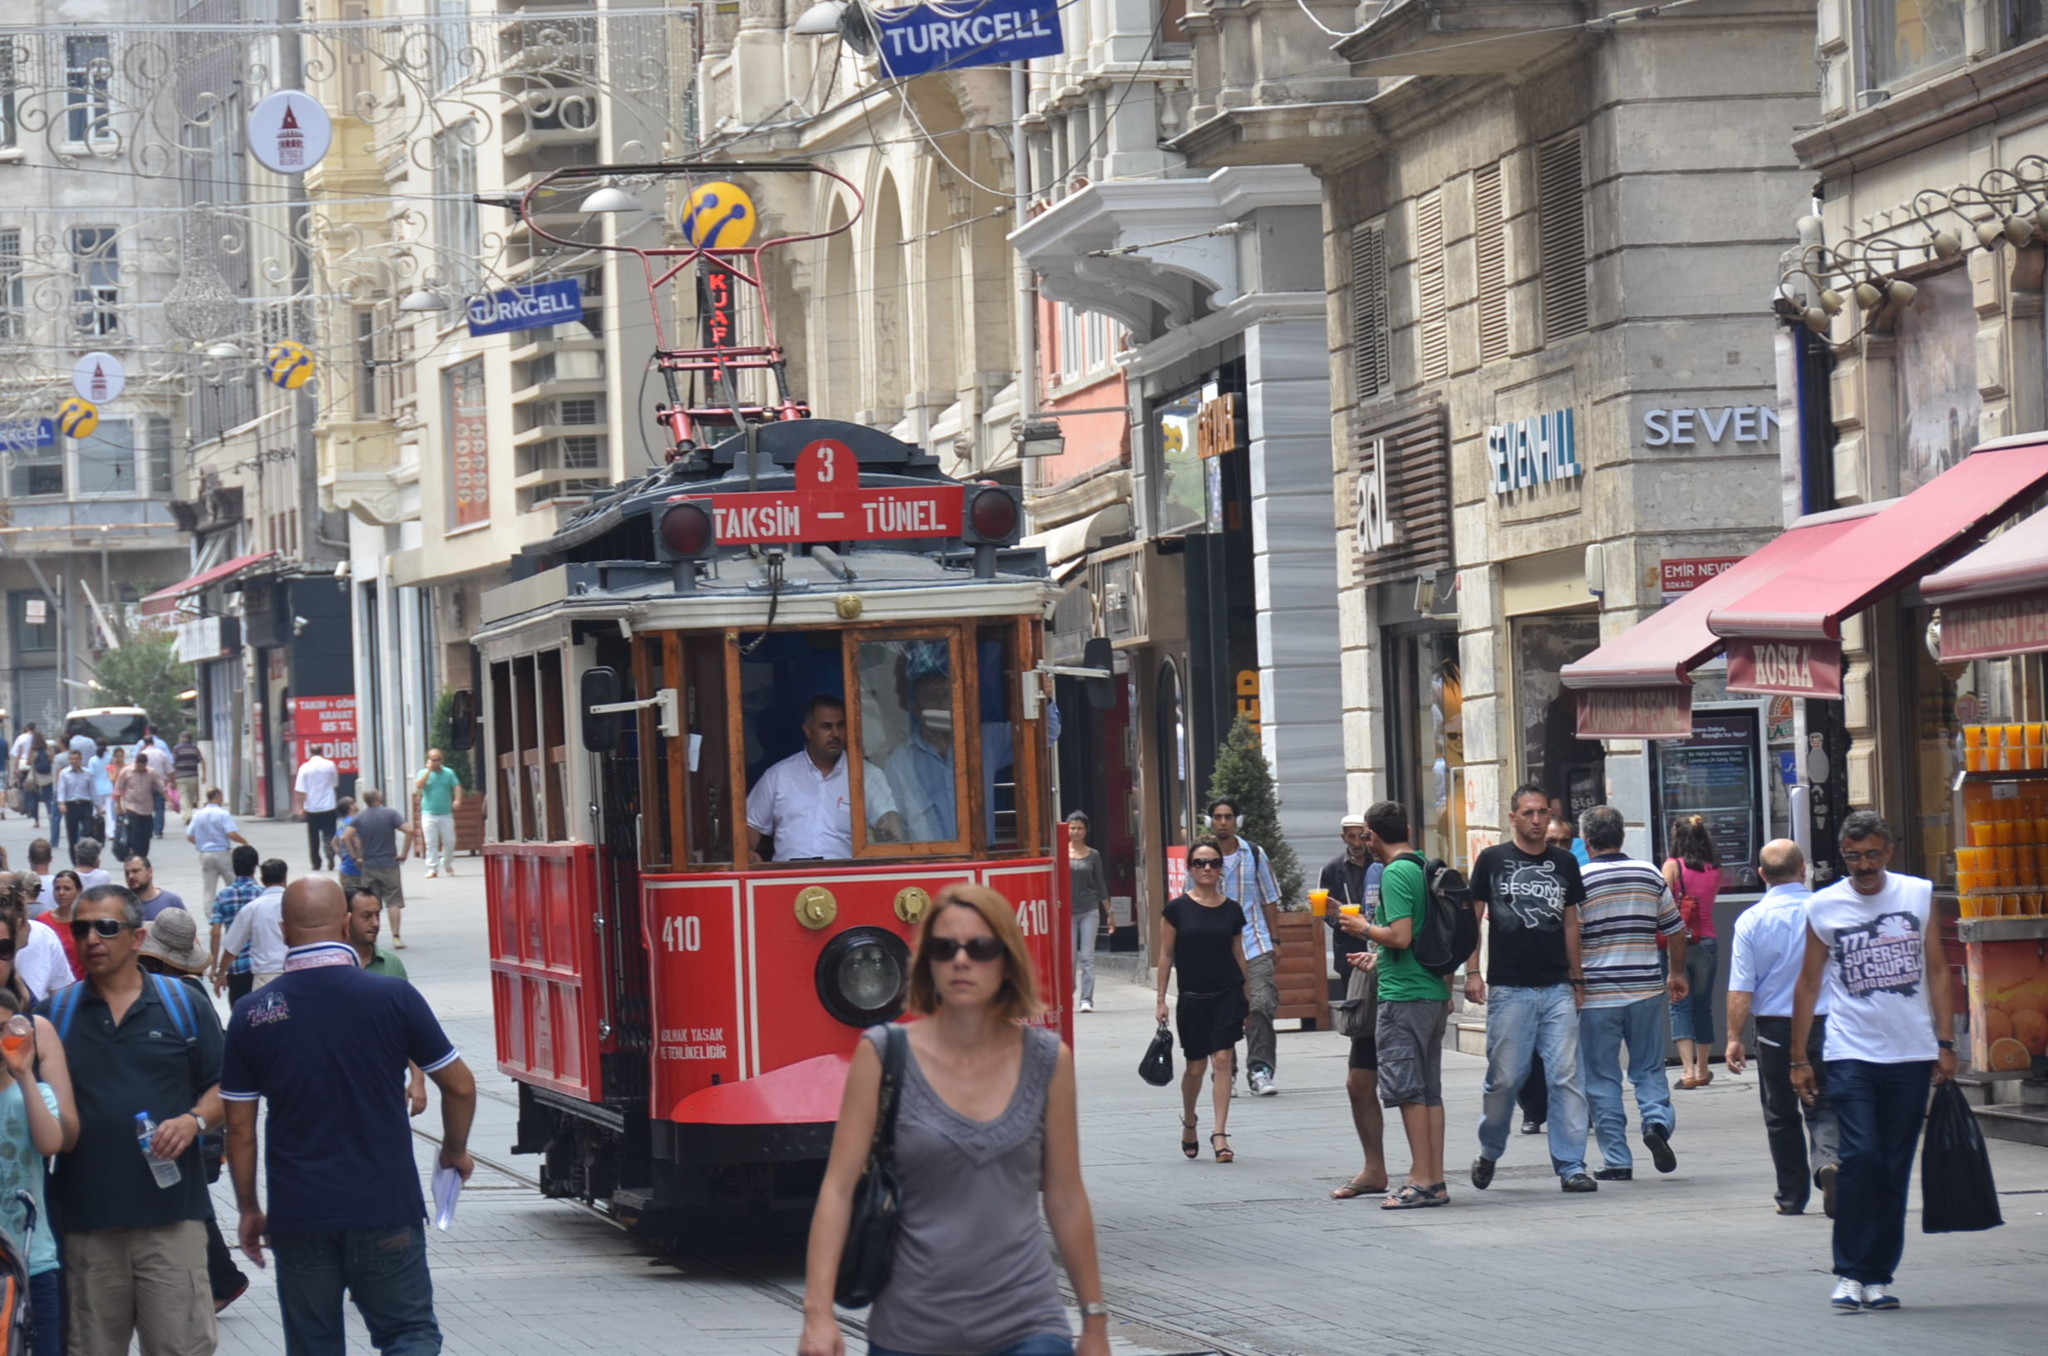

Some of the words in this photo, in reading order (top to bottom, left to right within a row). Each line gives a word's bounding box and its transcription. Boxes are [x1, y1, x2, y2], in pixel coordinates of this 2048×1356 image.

[885, 8, 1052, 57] TURKCELL
[817, 446, 834, 483] 3
[1488, 407, 1580, 496] SEVENHILL
[712, 500, 800, 539] TAKSİM
[862, 496, 947, 534] TÜNEL
[1664, 562, 1695, 578] EMİR
[1665, 581, 1694, 590] SOKAĞI
[1948, 601, 2018, 652] TURKISH
[1753, 643, 1814, 688] KOSKA
[339, 721, 354, 731] TL
[662, 916, 701, 952] 410
[1016, 899, 1048, 936] 410
[1840, 931, 1869, 954] 777
[1846, 966, 1862, 983] LA
[690, 1028, 724, 1042] YASAK
